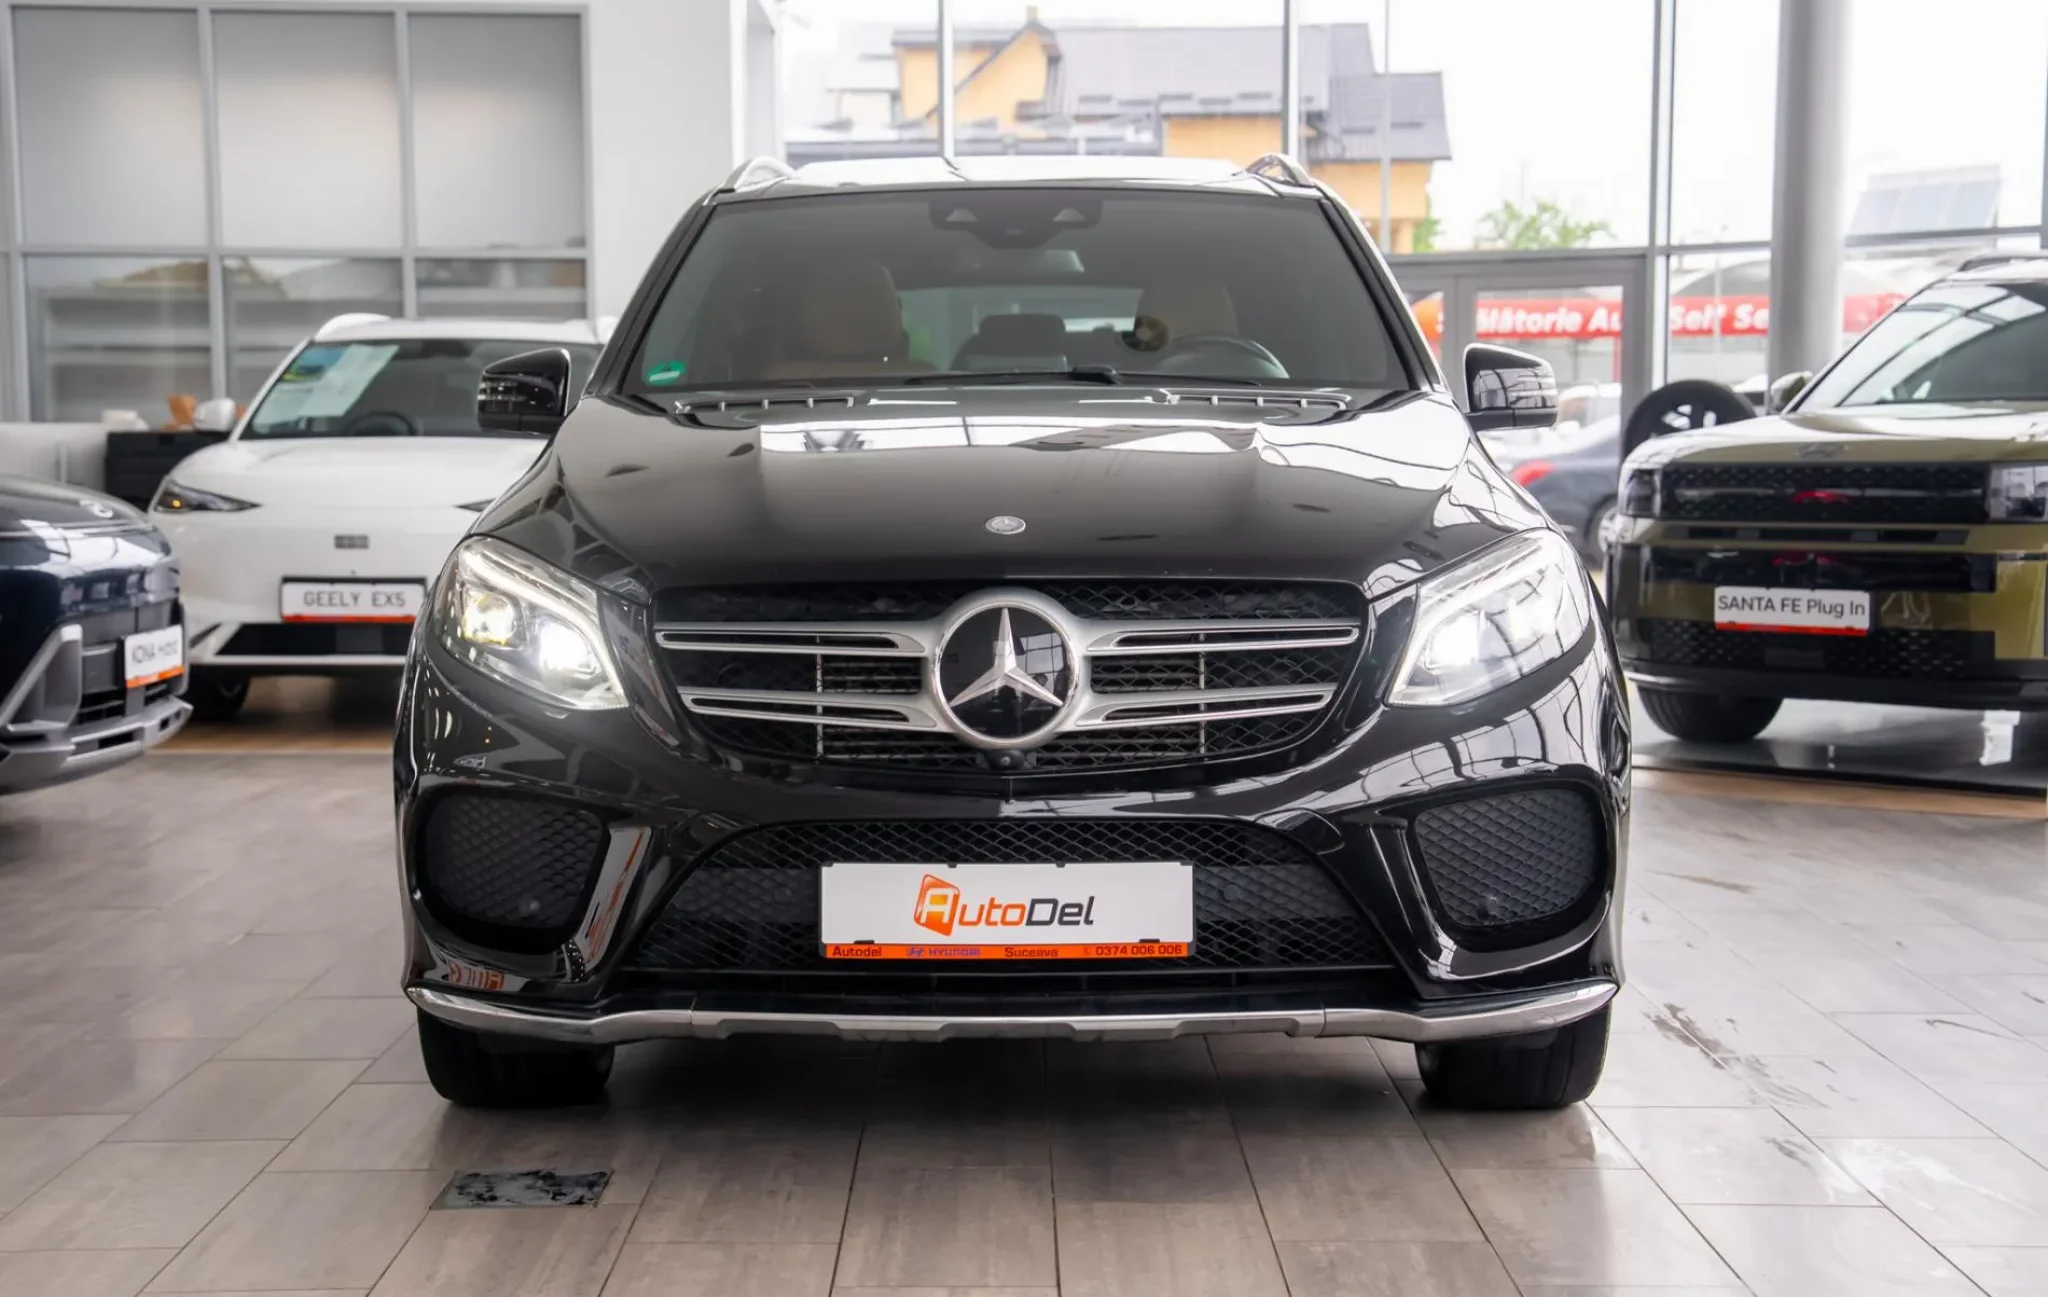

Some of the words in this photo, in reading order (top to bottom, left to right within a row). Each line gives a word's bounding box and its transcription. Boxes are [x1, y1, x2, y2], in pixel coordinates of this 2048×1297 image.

[1588, 307, 1622, 331] Au
[303, 591, 361, 607] GEELY
[371, 591, 406, 608] EX5
[1718, 595, 1776, 613] SANTA
[1781, 597, 1803, 613] FE
[1807, 599, 1845, 619] Plug
[1850, 601, 1866, 616] In
[914, 882, 1096, 930] AutoDel
[833, 945, 882, 957] Autodel
[1005, 947, 1058, 958] Suceava
[1096, 945, 1128, 956] 0374
[1131, 945, 1155, 956] 006
[1158, 944, 1182, 955] 006
